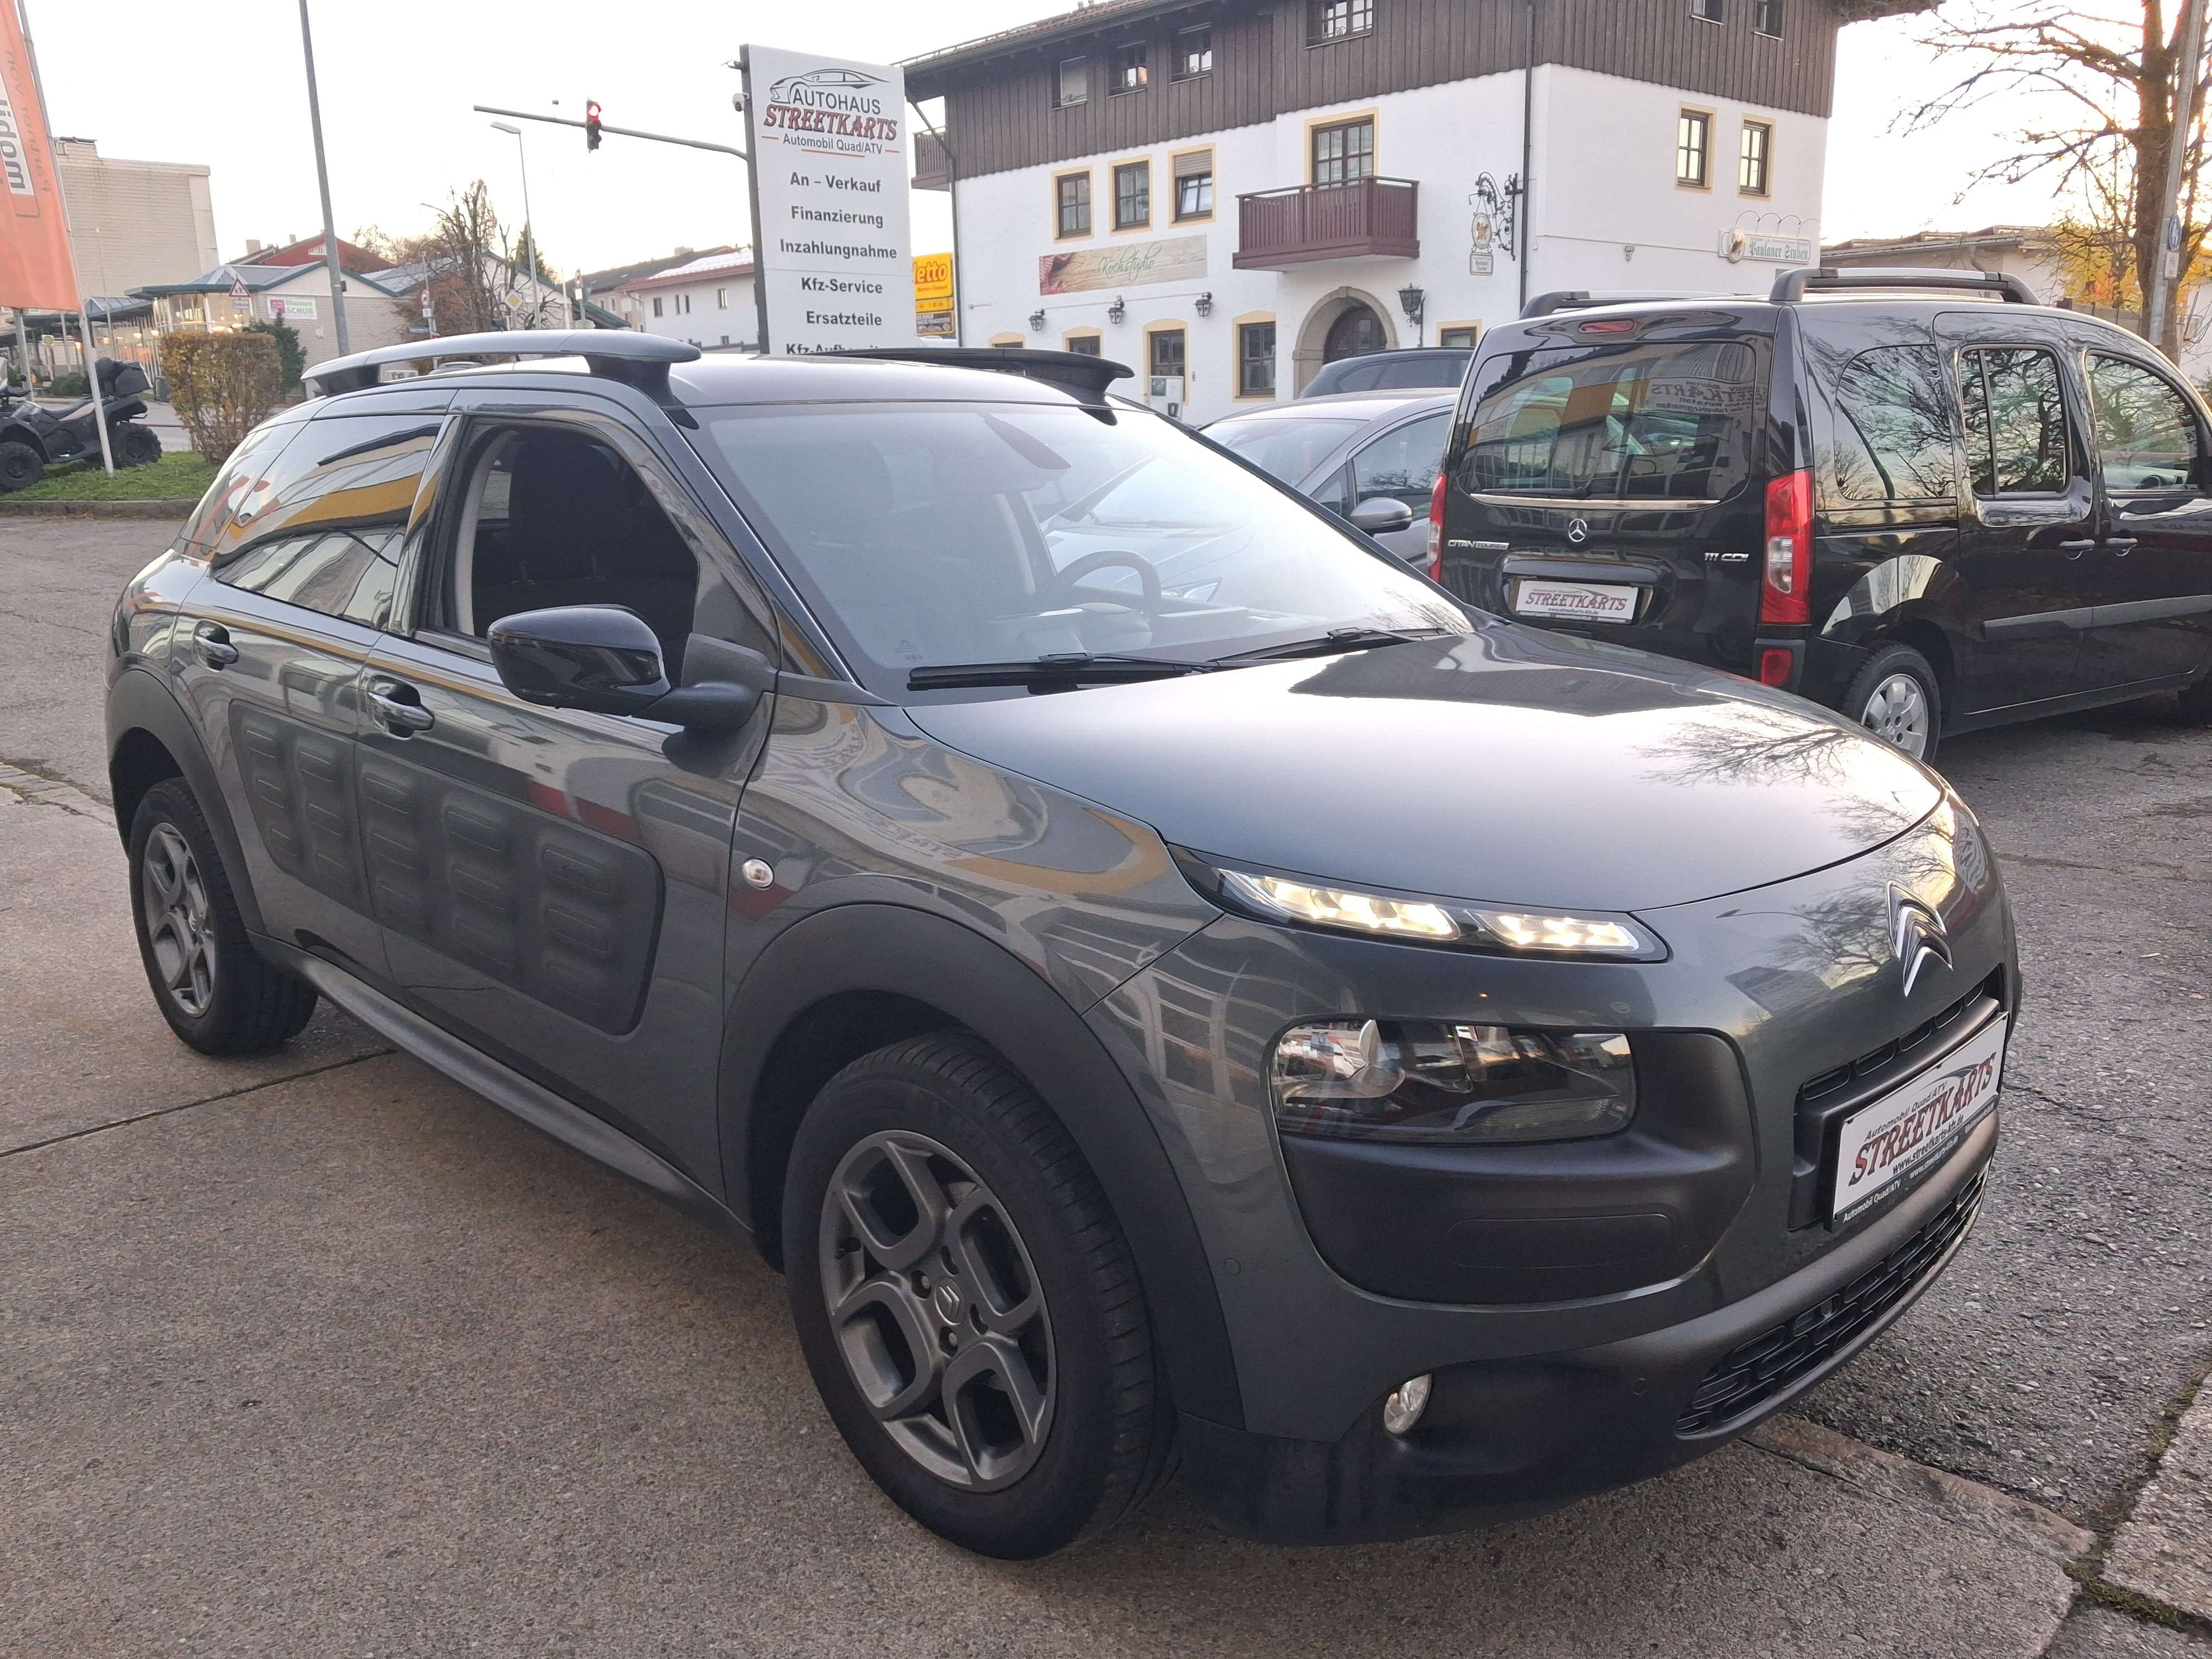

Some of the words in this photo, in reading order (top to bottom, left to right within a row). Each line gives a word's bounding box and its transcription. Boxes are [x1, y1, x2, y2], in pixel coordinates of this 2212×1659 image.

[793, 88, 881, 114] AUTOHAUS
[763, 104, 898, 141] STREETKARTS
[783, 133, 833, 149] Automobil
[837, 139, 882, 154] Quad/ATV
[790, 172, 809, 187] An
[825, 175, 881, 192] Verkauf
[791, 205, 883, 228] Finanzierung
[780, 239, 897, 259] Inzahlungnahme
[1750, 241, 1782, 258] Paulaner
[1784, 245, 1808, 260] Stuben
[801, 277, 883, 294] Kfz-Service
[806, 311, 882, 326] Ersatzteile
[1448, 539, 1476, 548] CITAN
[1721, 553, 1750, 562] CDI
[1525, 592, 1629, 611] STREETKARTS
[1848, 1051, 1997, 1187] STREETKARTS
[1864, 1105, 1911, 1142] Automobil
[1843, 1195, 1874, 1224] Automobil
